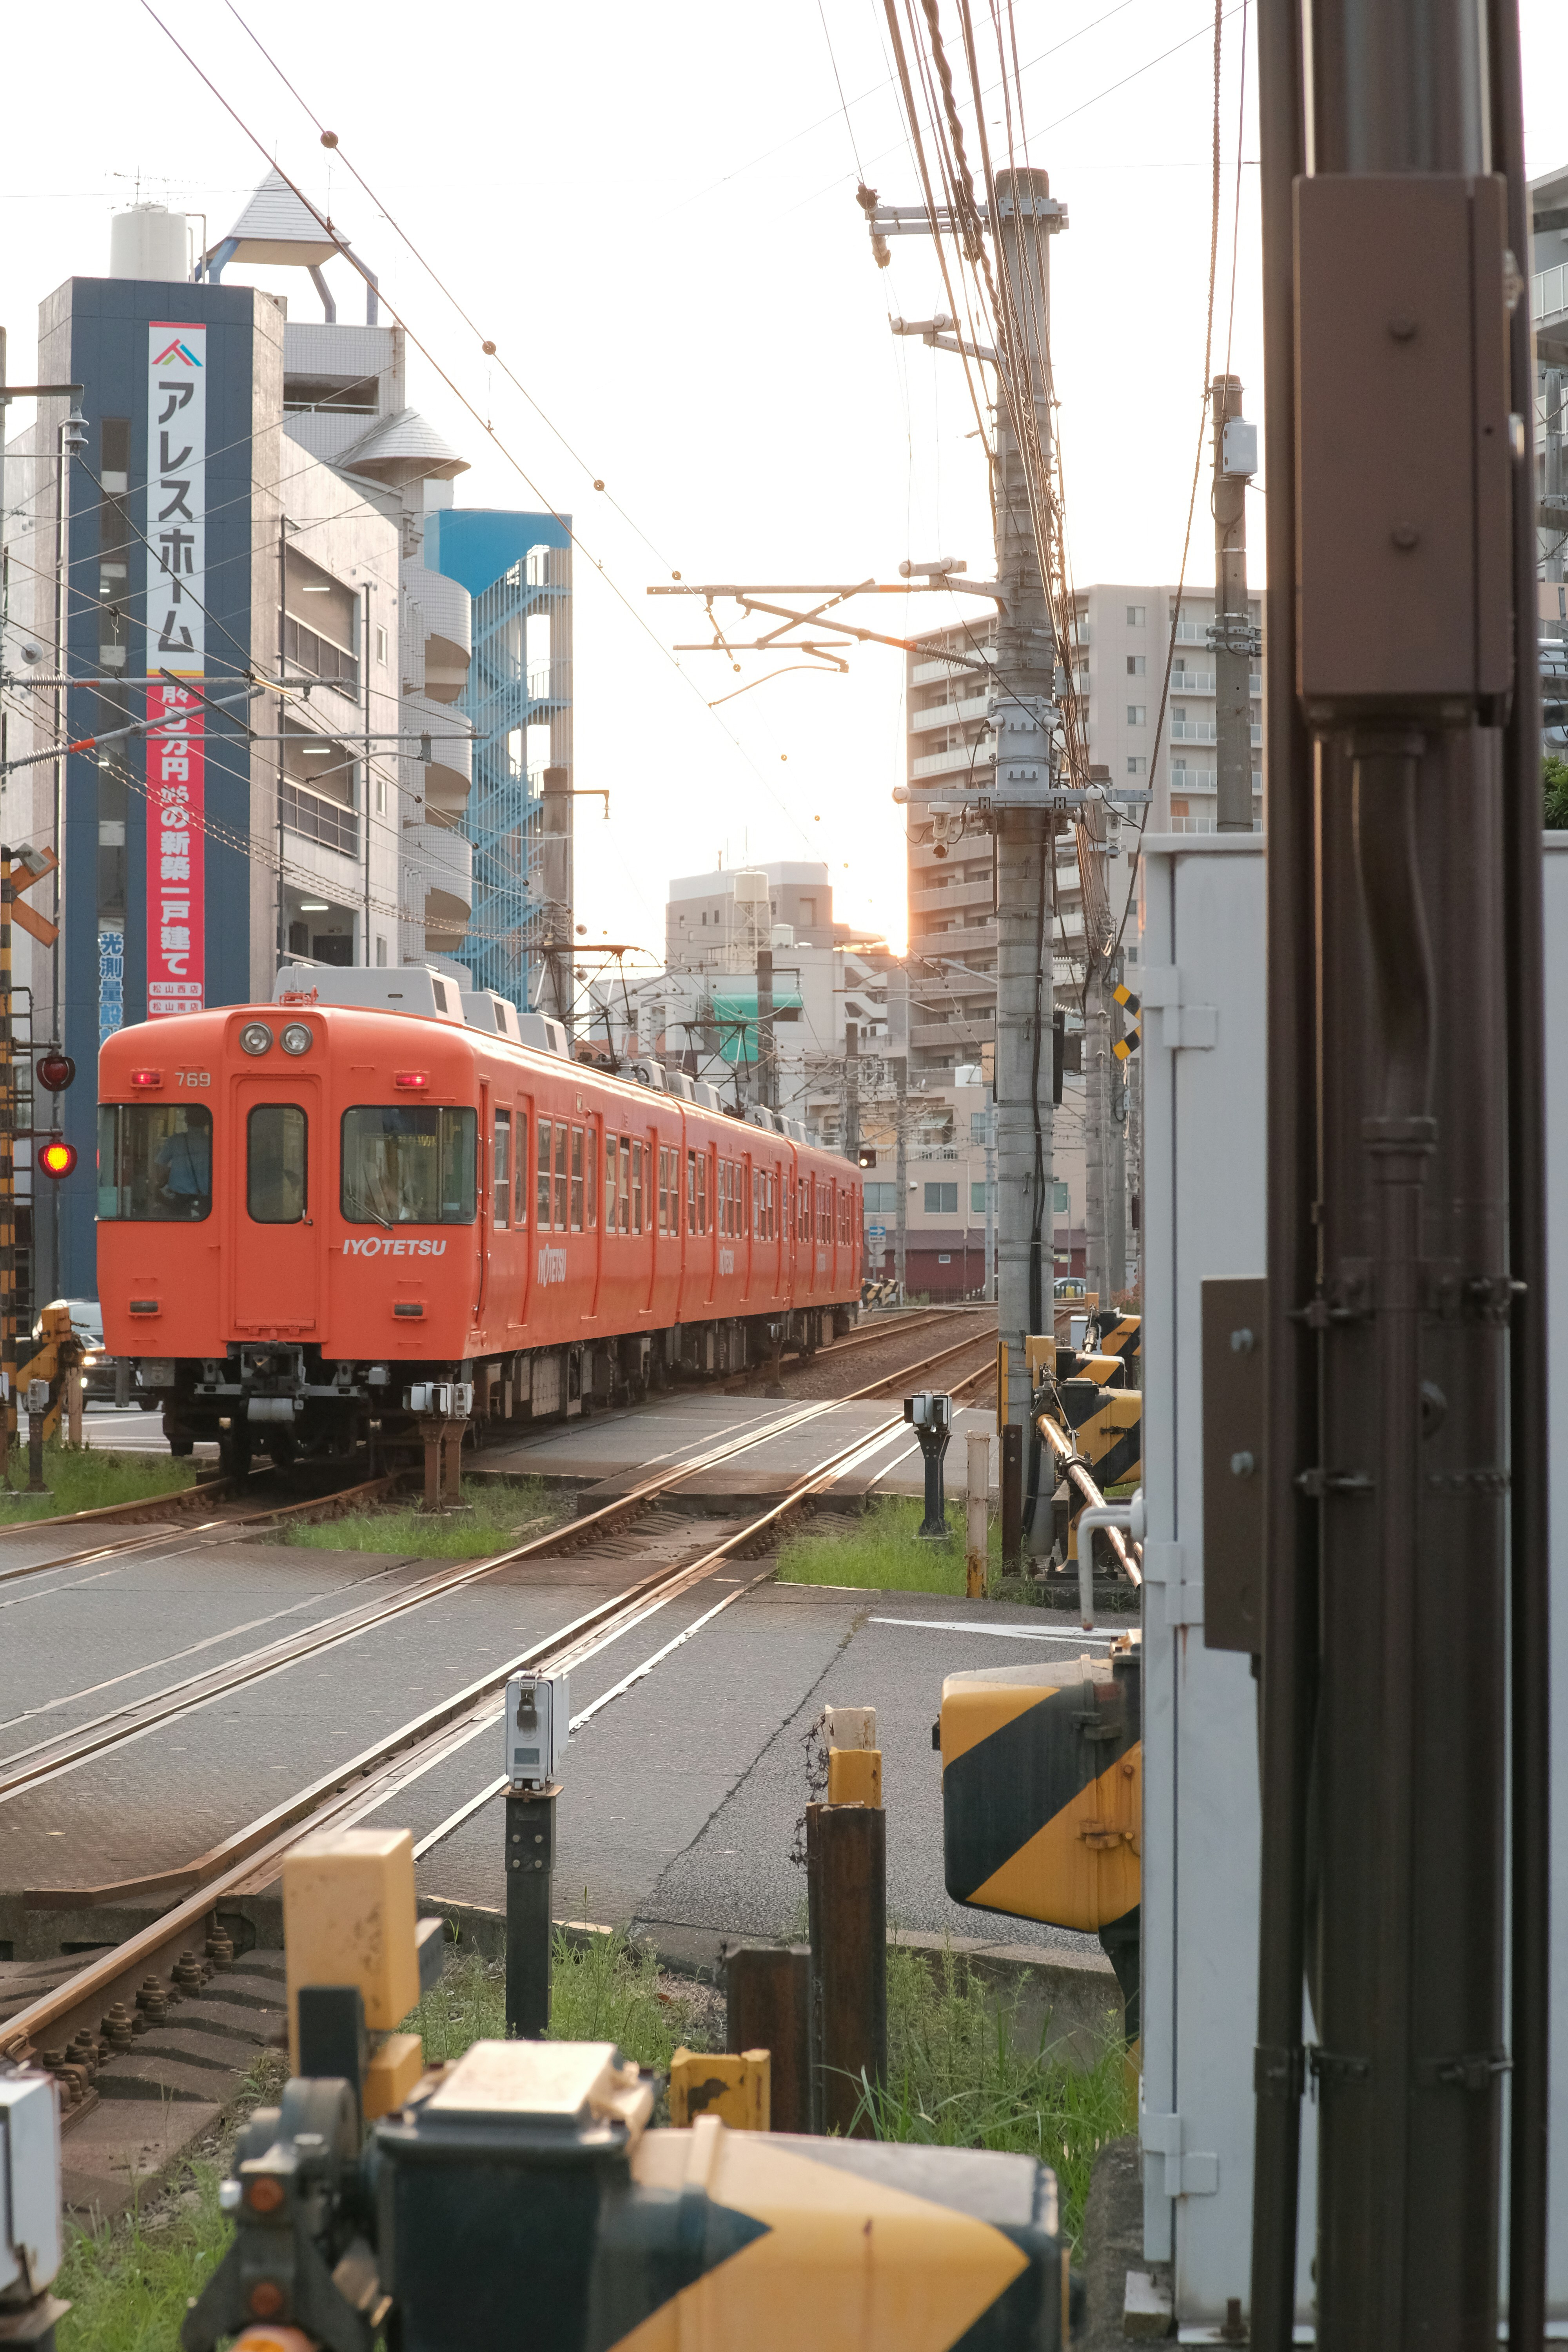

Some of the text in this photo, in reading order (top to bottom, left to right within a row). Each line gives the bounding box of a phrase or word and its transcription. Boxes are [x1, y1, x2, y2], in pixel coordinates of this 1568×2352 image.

[158, 381, 194, 653] アレスホーム
[152, 984, 198, 994] 松山西店
[152, 1002, 198, 1012] 松山南店
[175, 1072, 211, 1087] 769
[343, 1237, 447, 1257] IYOTETSU
[537, 1242, 567, 1288] IYOTETSU
